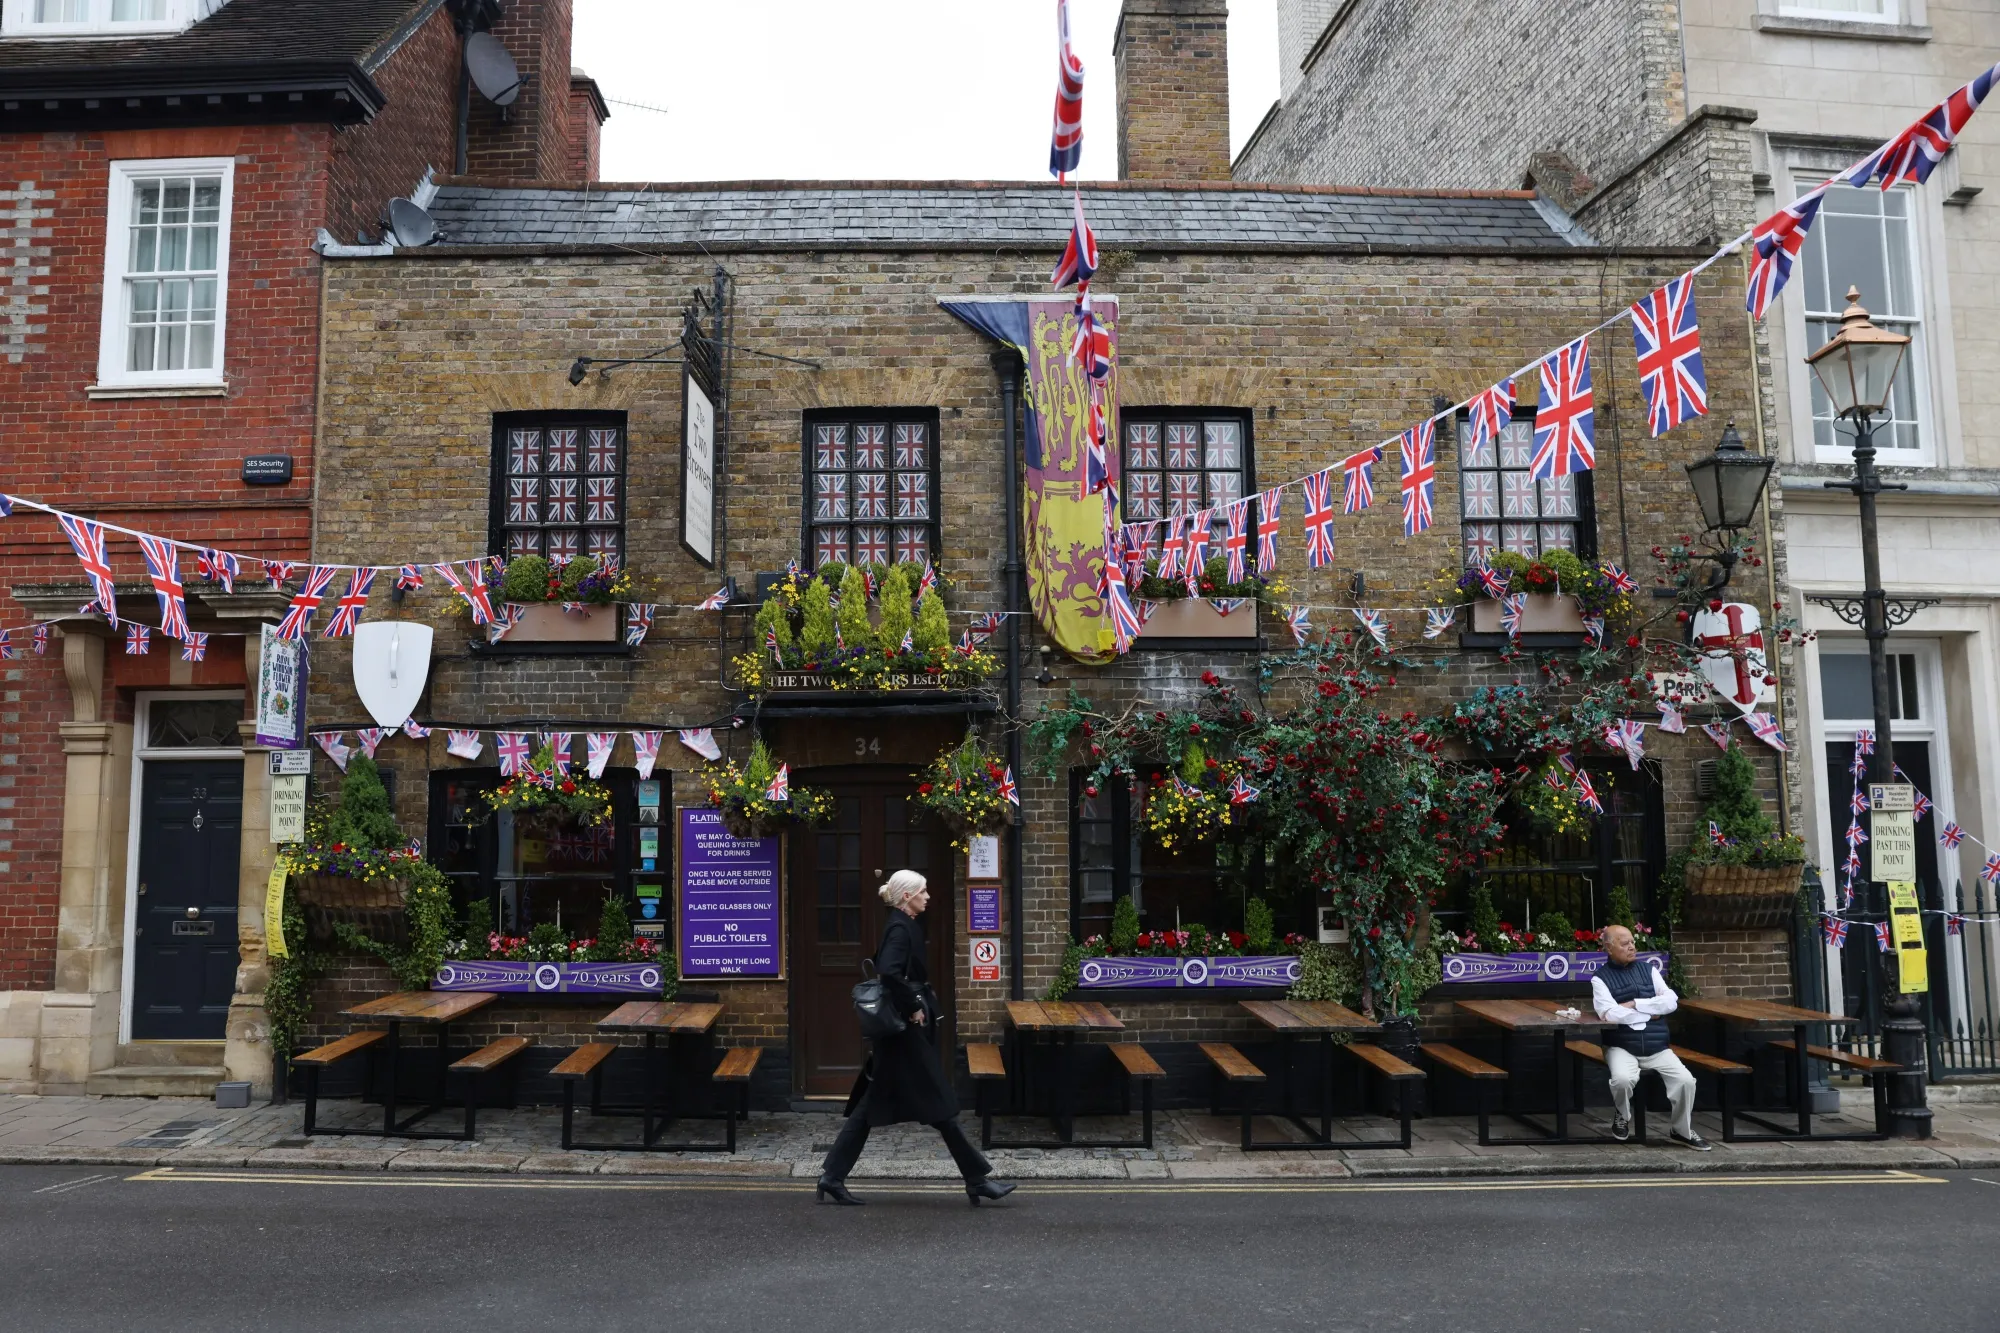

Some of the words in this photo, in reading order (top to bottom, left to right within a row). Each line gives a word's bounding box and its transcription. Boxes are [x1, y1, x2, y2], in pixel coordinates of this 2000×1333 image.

[696, 402, 706, 428] The
[694, 422, 708, 458] Two
[686, 445, 712, 494] Brewers
[276, 654, 290, 665] ROYAL
[272, 662, 292, 676] WINDSOR
[273, 672, 291, 684] FLOWER
[768, 676, 798, 687] THE
[800, 676, 834, 687] TWO
[275, 682, 289, 693] SHOW
[855, 737, 880, 755] 34
[273, 754, 281, 762] P
[285, 778, 293, 787] NO
[192, 787, 207, 799] 33
[275, 790, 302, 800] DRINKING
[1874, 788, 1882, 797] P
[275, 804, 288, 813] PAST
[289, 804, 302, 813] THIS
[279, 817, 296, 826] POINT
[1888, 812, 1897, 822] NO
[1876, 826, 1910, 836] DRINKING
[1876, 840, 1893, 850] PAST
[1895, 840, 1911, 851] THIS
[1883, 855, 1904, 865] POINT
[693, 934, 727, 942] PUBLIC
[1107, 967, 1134, 978] 1952
[1148, 967, 1179, 977] 2022
[1218, 966, 1236, 977] 70
[1241, 966, 1277, 980] years
[1470, 962, 1497, 974] 1952
[1511, 963, 1540, 973] 2022
[1580, 961, 1597, 973] 70
[460, 971, 487, 982] 1952
[501, 972, 531, 982] 2022
[570, 971, 589, 983] 70
[594, 972, 631, 987] years
